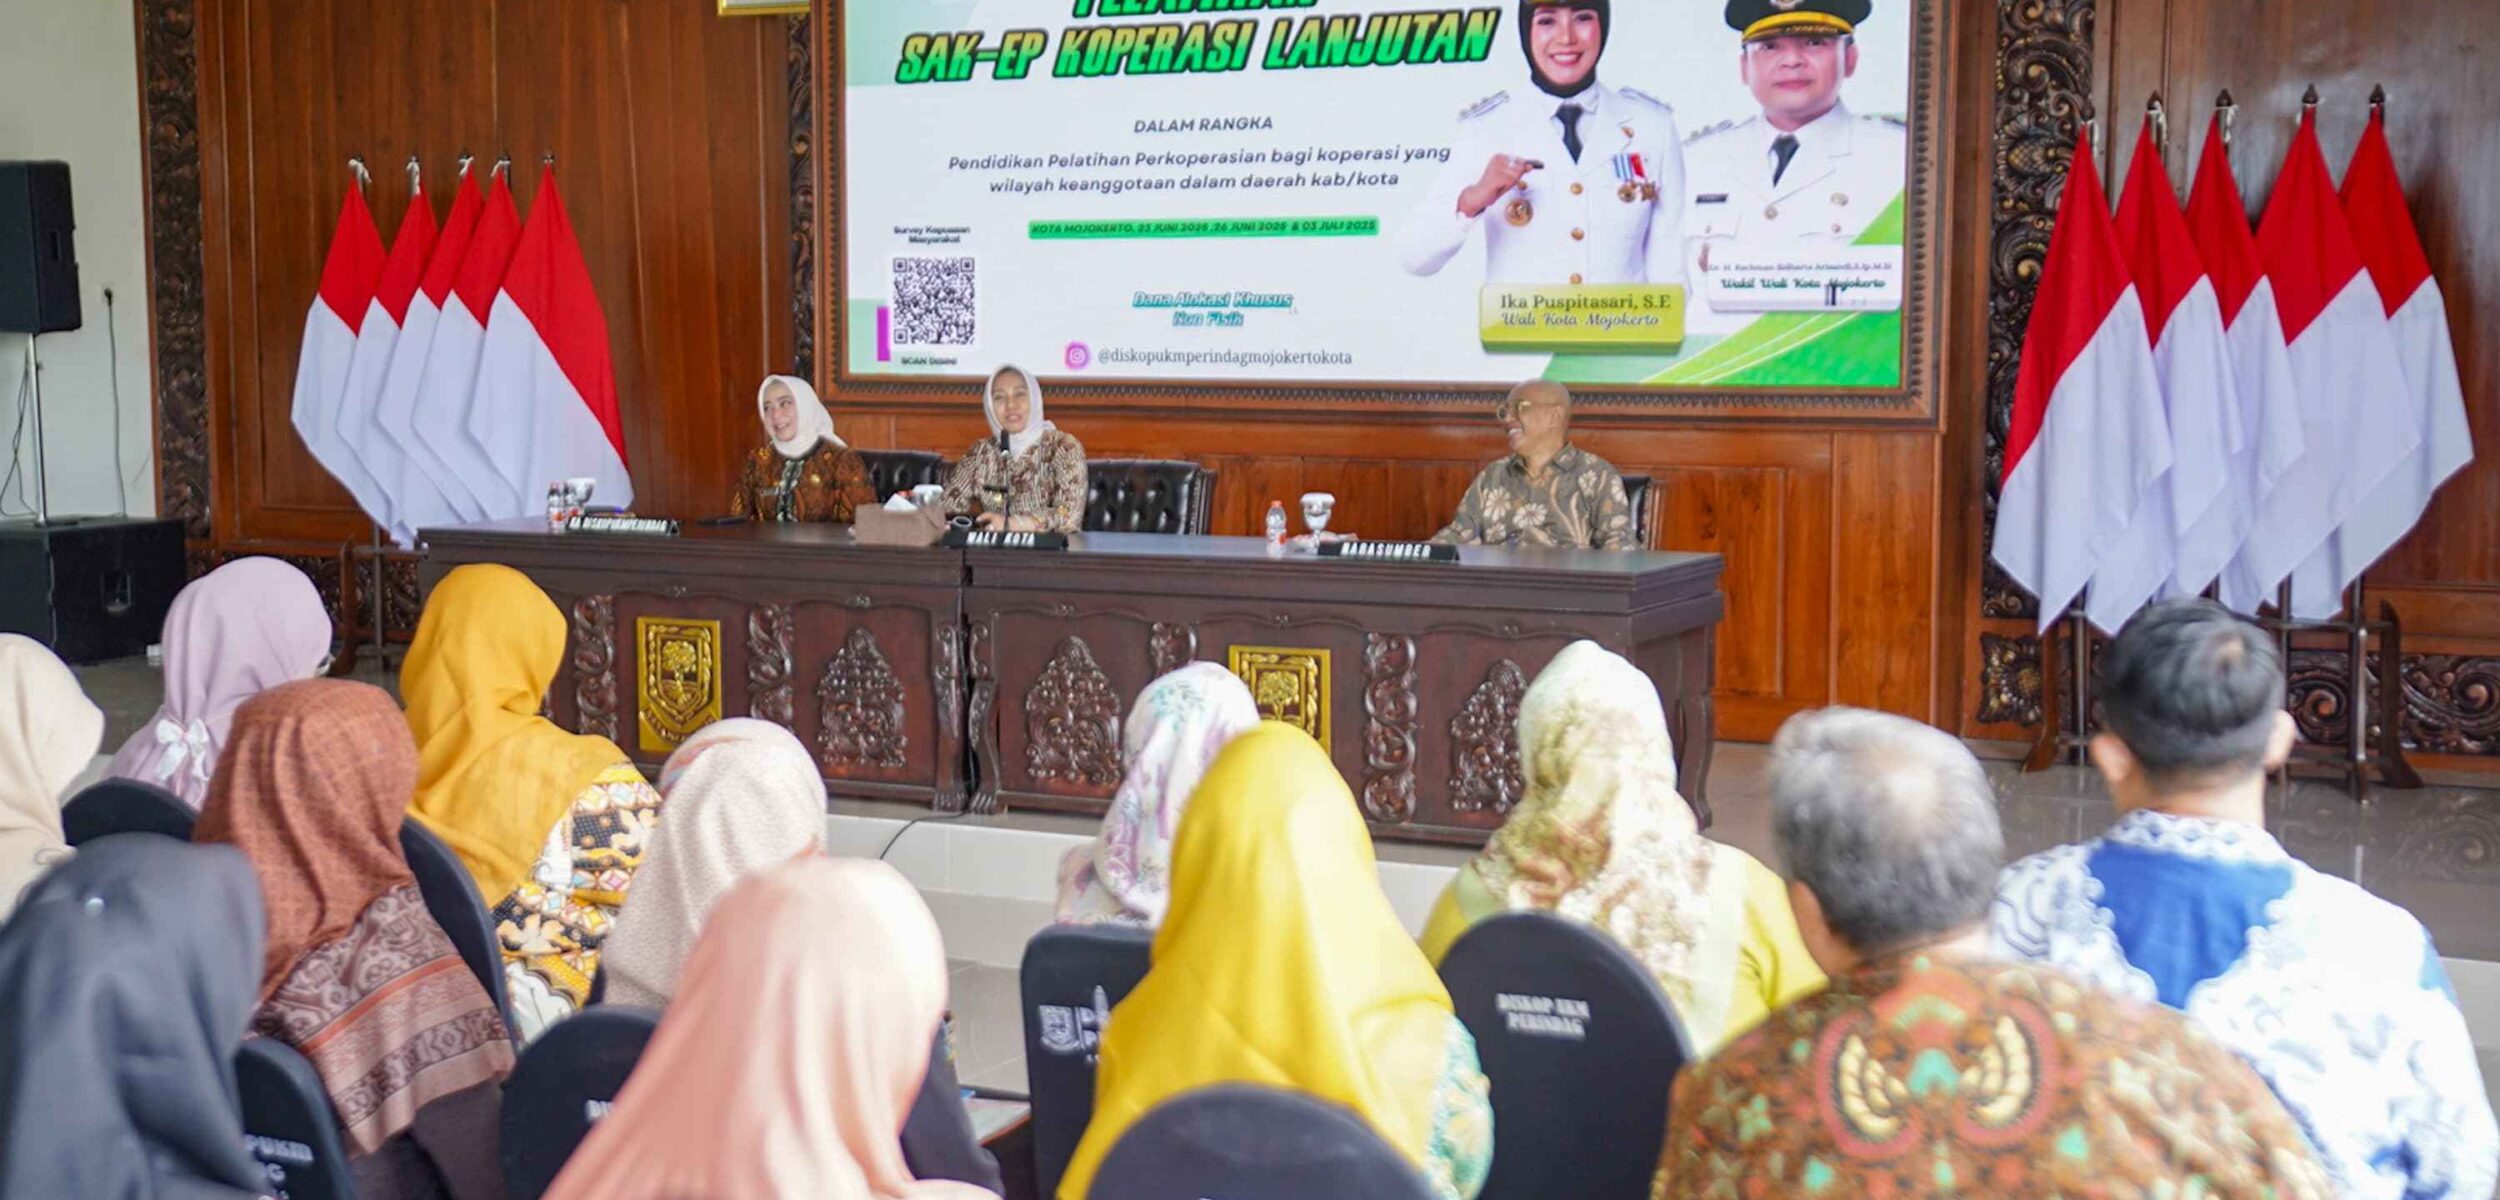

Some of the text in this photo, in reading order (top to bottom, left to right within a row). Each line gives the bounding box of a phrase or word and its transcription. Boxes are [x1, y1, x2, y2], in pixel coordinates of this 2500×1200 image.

[895, 8, 1501, 83] SAK-EP KOPERASI LANJUTAN
[1133, 116, 1274, 133] DALAM RANGKA
[949, 145, 1451, 170] Pendidikan Pelatihan Perkoperasian bagi koperasi yang
[989, 171, 1400, 195] wilayah keanggotaan dalam daerah kab/kota
[1031, 223, 1062, 234] KOTA
[1153, 222, 1180, 233] JUNI
[1230, 221, 1256, 232] JUNI
[1318, 219, 1345, 231] JULI
[1720, 277, 1755, 289] Wakil
[1760, 277, 1788, 289] Wali
[1794, 277, 1821, 289] Kota
[1132, 290, 1293, 307] Dana Alokasi Khusus
[1501, 293, 1671, 311] Ika Puspitasari, S.E
[1500, 312, 1659, 331] Wali Kota Mojokerto
[1098, 347, 1353, 367] @diskopukmperindagmojokertokota
[966, 532, 1035, 546] WALI KOTA
[1340, 541, 1432, 557] NARASUMBER
